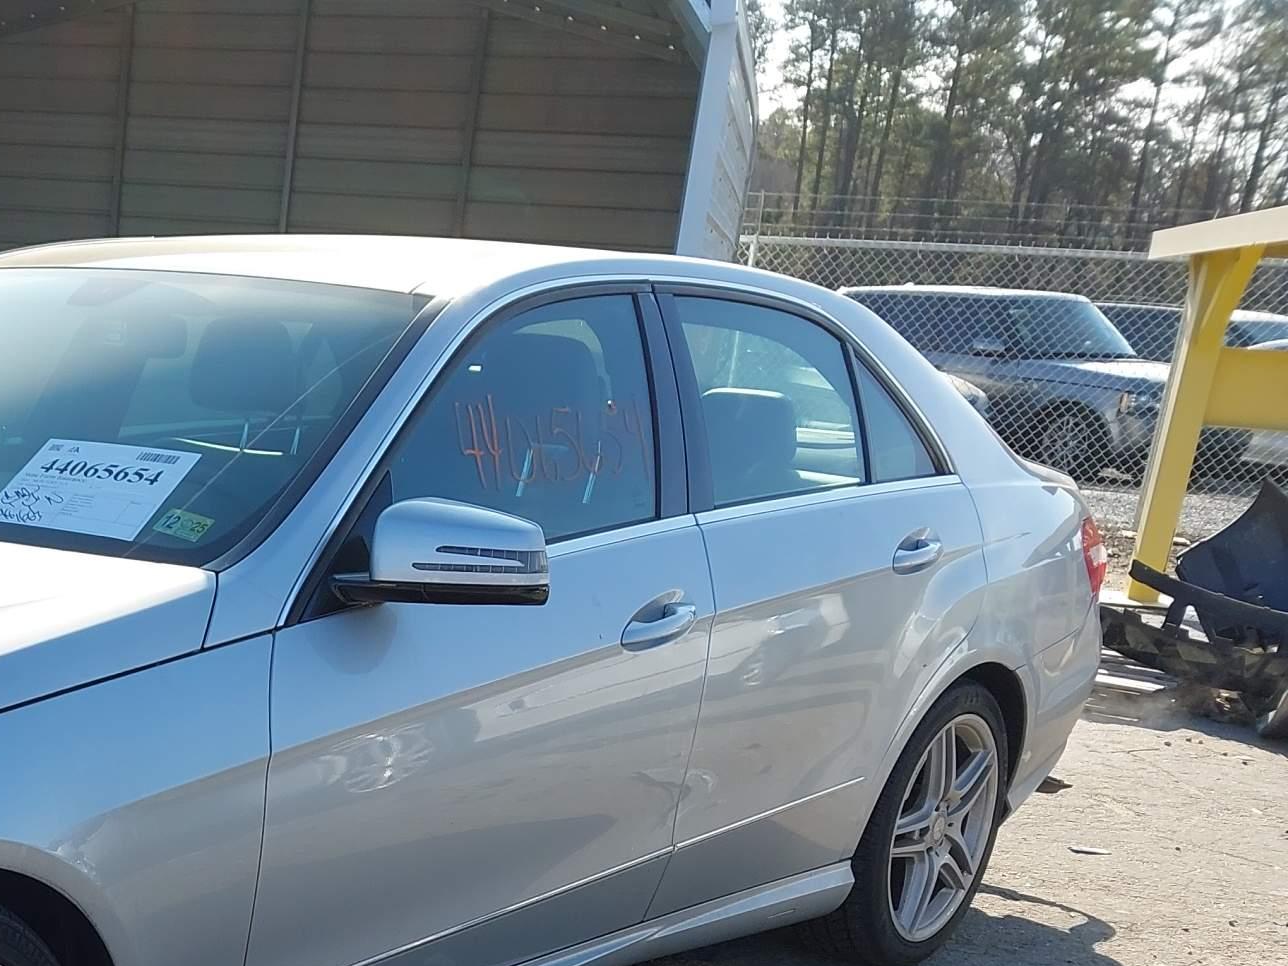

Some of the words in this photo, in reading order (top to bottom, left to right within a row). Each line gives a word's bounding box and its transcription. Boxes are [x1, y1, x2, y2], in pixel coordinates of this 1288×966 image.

[40, 459, 164, 486] 44065654
[162, 514, 181, 529] 12
[190, 521, 208, 533] 25
